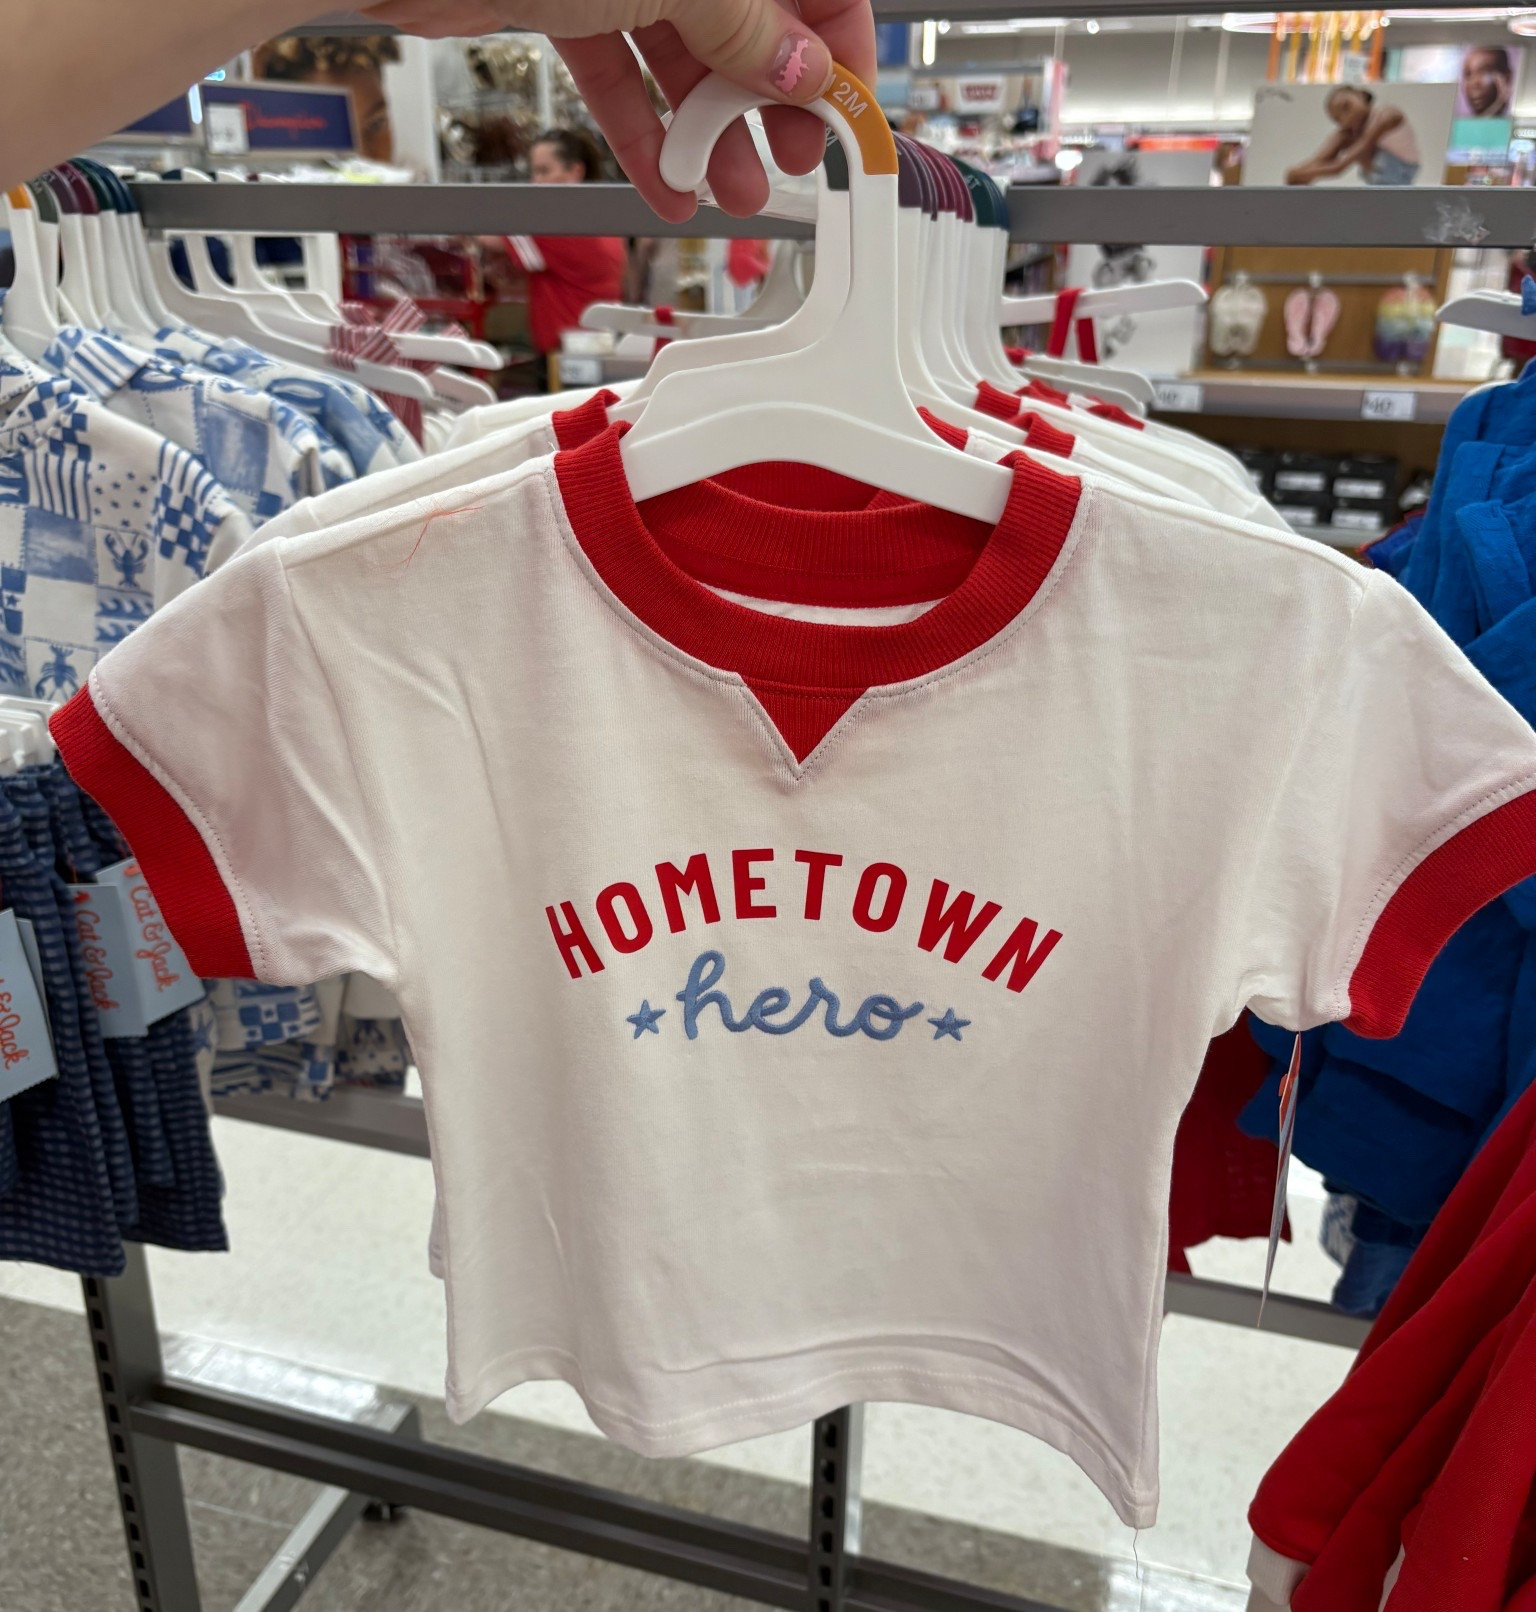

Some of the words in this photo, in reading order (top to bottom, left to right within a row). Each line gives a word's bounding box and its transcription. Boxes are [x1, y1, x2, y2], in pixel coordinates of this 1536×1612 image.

[76, 908, 102, 942] Cat
[129, 885, 158, 923] Cat
[545, 848, 1063, 993] HOMETOWN
[84, 966, 120, 1010] Jack
[135, 941, 181, 993] Jack
[676, 950, 924, 1041] hero
